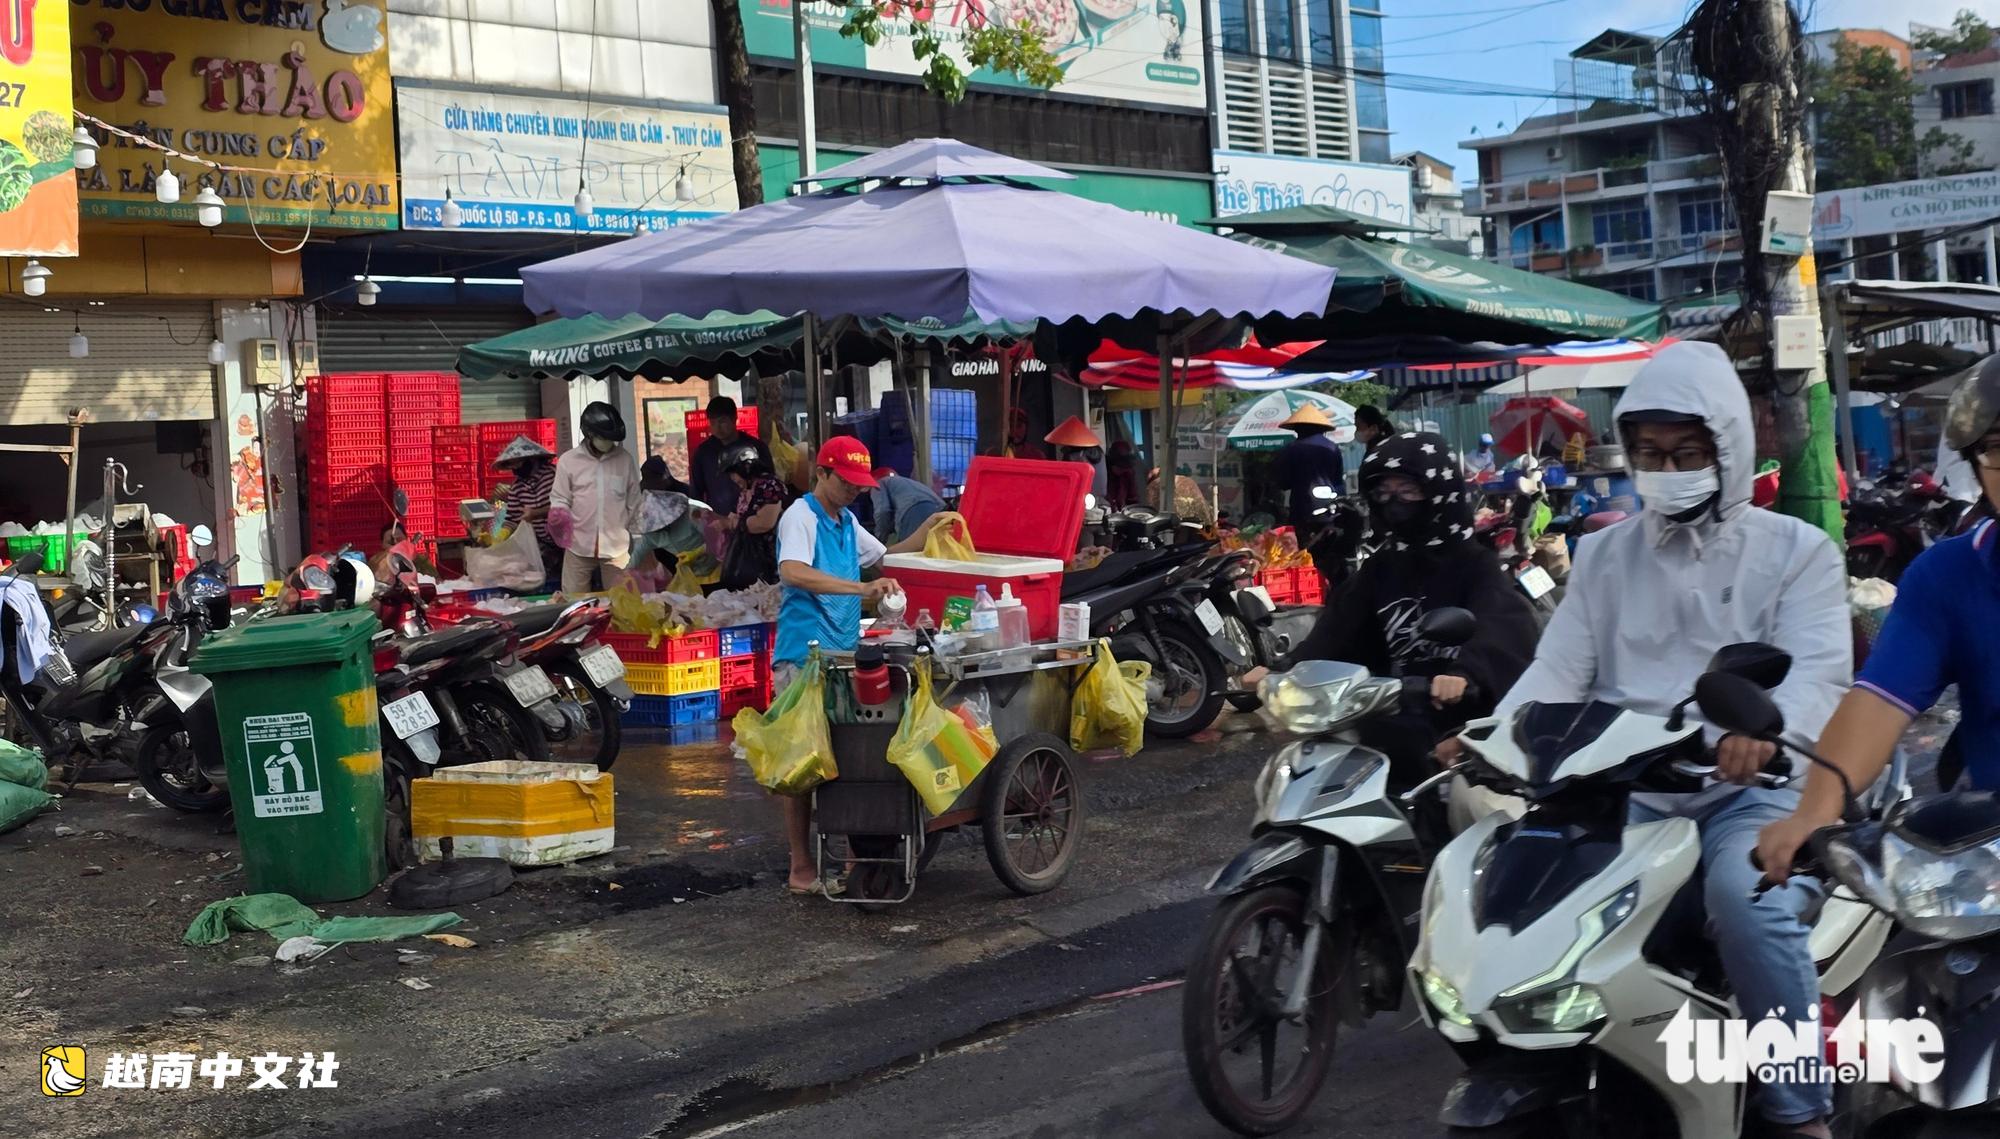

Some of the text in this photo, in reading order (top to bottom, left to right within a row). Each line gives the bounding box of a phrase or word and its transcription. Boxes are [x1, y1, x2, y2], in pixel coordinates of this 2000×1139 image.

[193, 41, 365, 122] THẢO
[444, 102, 469, 130] CỬA
[472, 104, 503, 132] HÀNG
[506, 110, 550, 136] CHUYÊN
[553, 116, 579, 138] KINH
[582, 119, 618, 140] DOANH
[620, 122, 637, 142] GIA
[640, 117, 663, 144] CẦM
[183, 128, 260, 157] CUNG
[268, 127, 326, 161] CẤP
[1217, 182, 1249, 212] hè
[413, 206, 433, 222] ĐC:
[459, 204, 487, 225] QUỐC
[489, 205, 502, 227] LỘ
[505, 210, 519, 225] 50
[528, 211, 545, 226] P.6
[554, 211, 571, 227] Q.8
[651, 216, 669, 231] 593
[529, 343, 590, 367] MKING
[593, 338, 643, 358] COFFEE
[645, 336, 653, 350] &
[656, 332, 680, 349] TEA
[951, 361, 978, 376] GIAO
